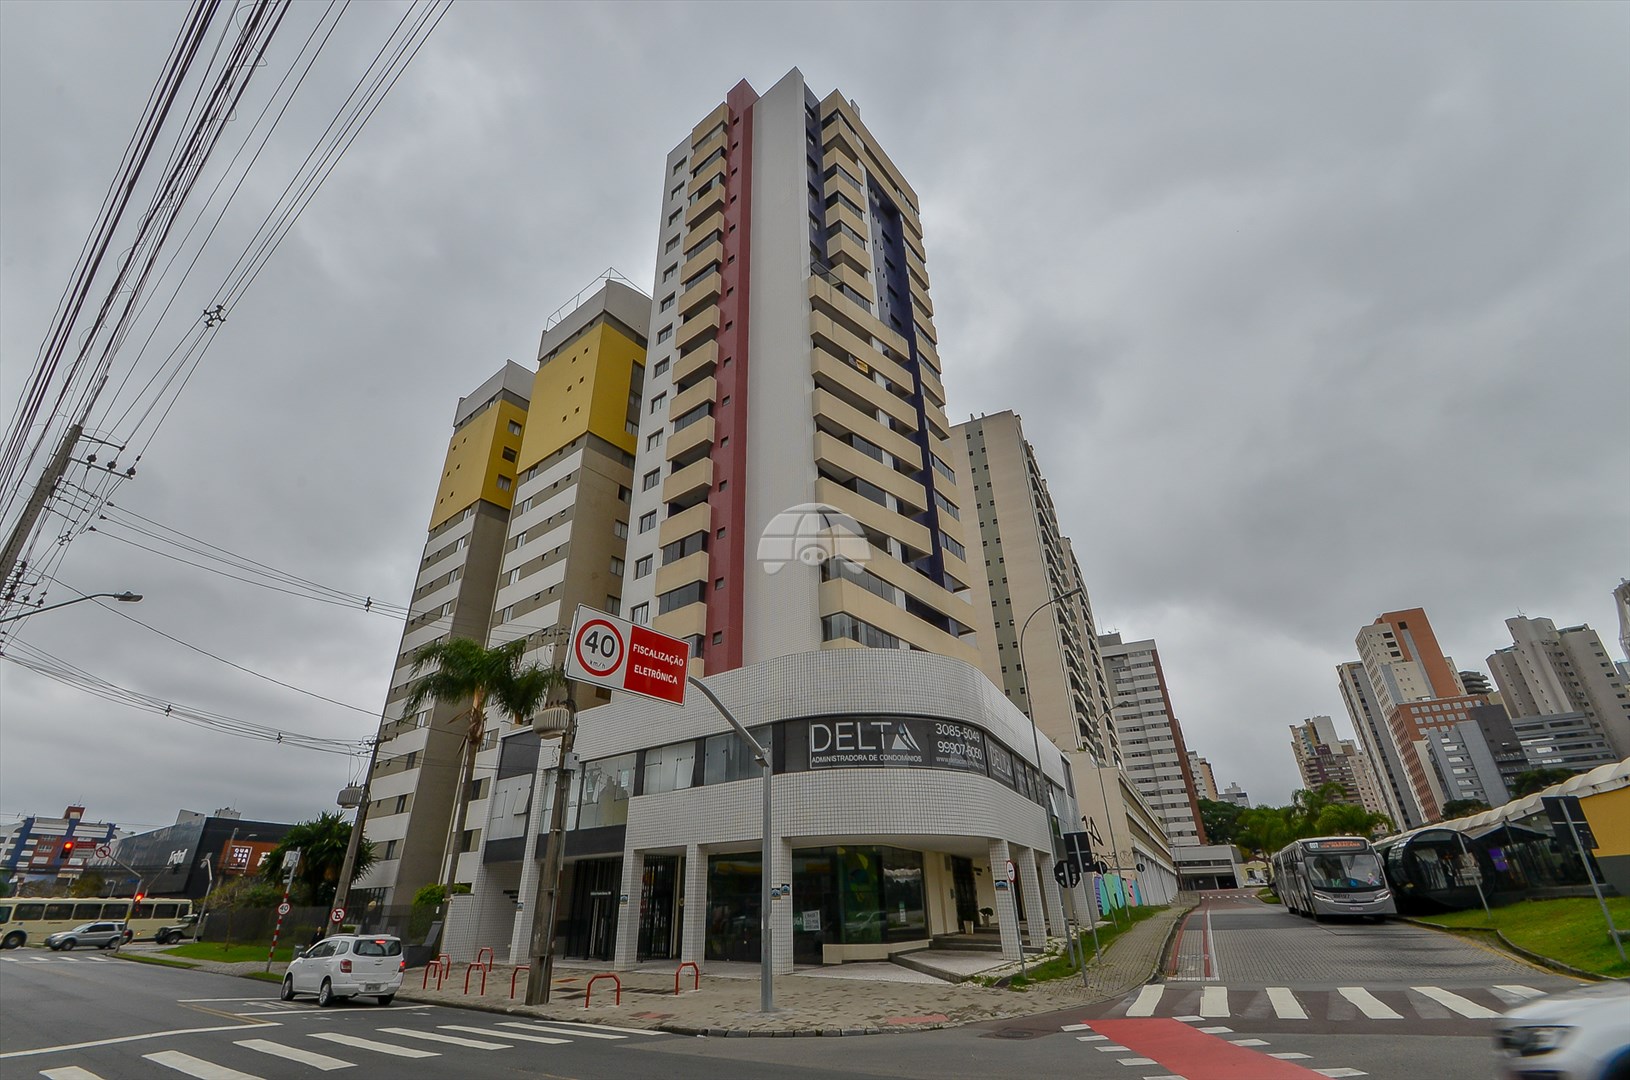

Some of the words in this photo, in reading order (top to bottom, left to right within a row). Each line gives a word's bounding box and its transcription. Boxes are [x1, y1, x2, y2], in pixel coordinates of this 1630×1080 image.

[584, 631, 615, 658] 40
[633, 643, 684, 667] FISCALIZAÇÃO
[590, 660, 606, 669] km/h
[634, 664, 678, 685] ELETRÔNICA
[811, 722, 921, 752] DELTA
[935, 723, 980, 743] 3085-5049
[811, 754, 867, 764] ADMINISTRADORA
[879, 753, 922, 763] CONDOMÍNIOS
